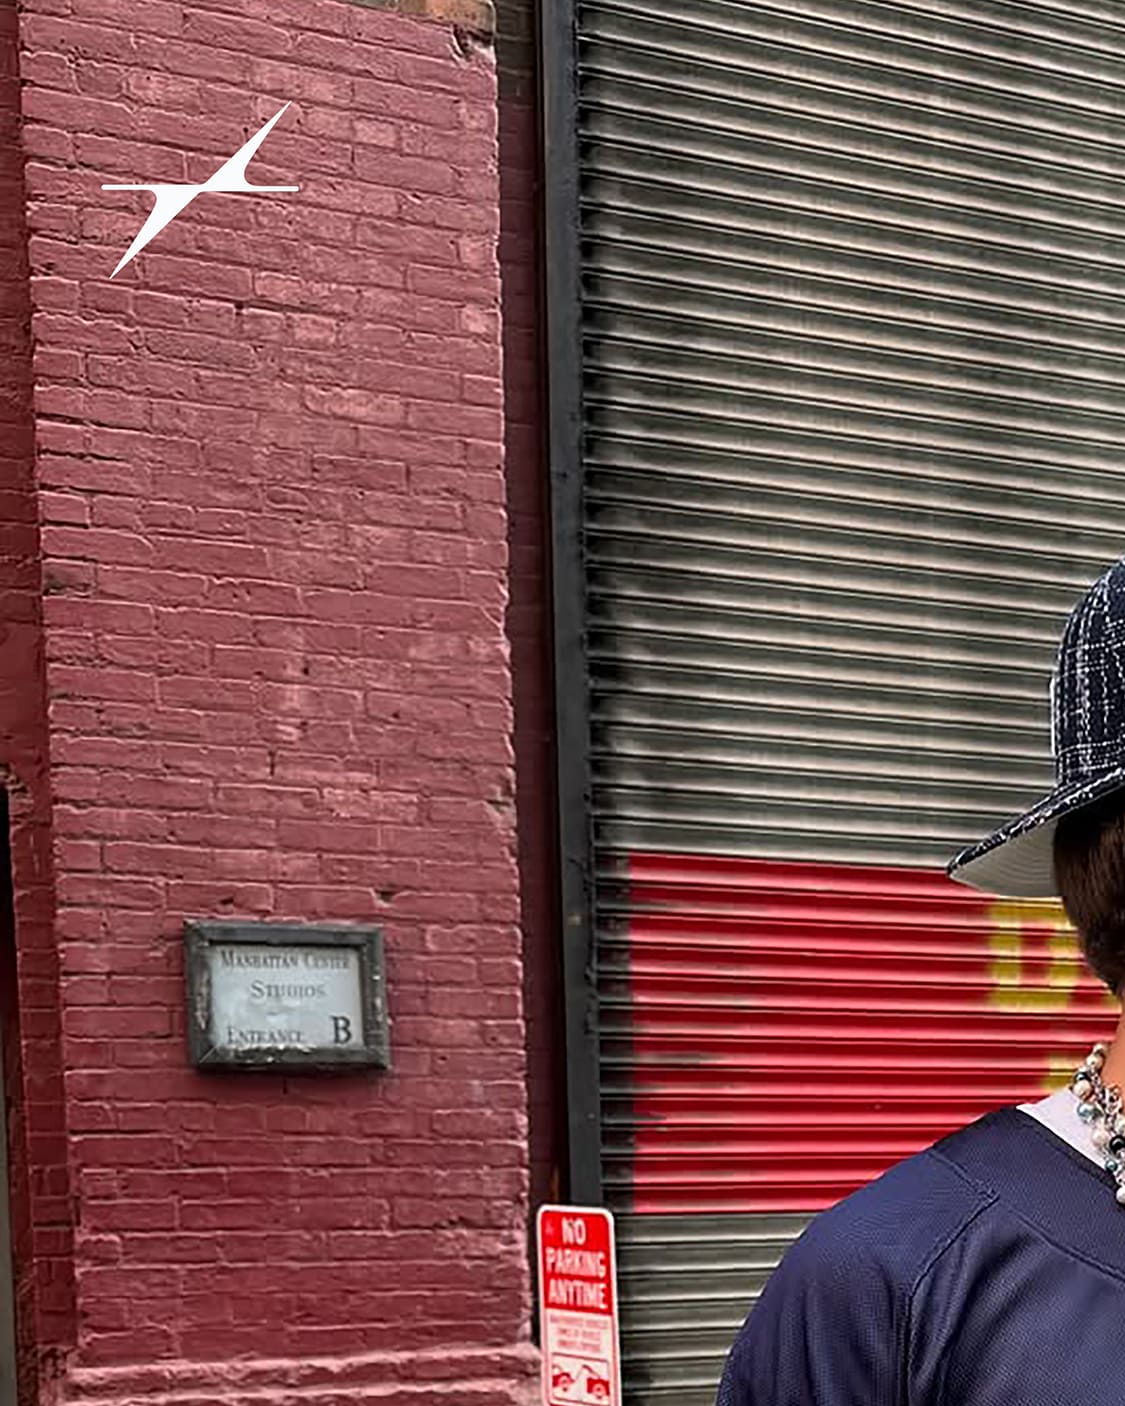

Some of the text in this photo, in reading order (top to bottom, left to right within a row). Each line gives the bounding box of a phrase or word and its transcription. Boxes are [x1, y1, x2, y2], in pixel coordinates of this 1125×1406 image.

[220, 950, 350, 969] MANHATTAN CENTER
[250, 979, 327, 999] STUDIOS
[227, 1015, 351, 1045] ENTRANCE B
[561, 1217, 587, 1245] NO
[546, 1246, 606, 1278] PARKING
[549, 1278, 608, 1310] ANYTIME
